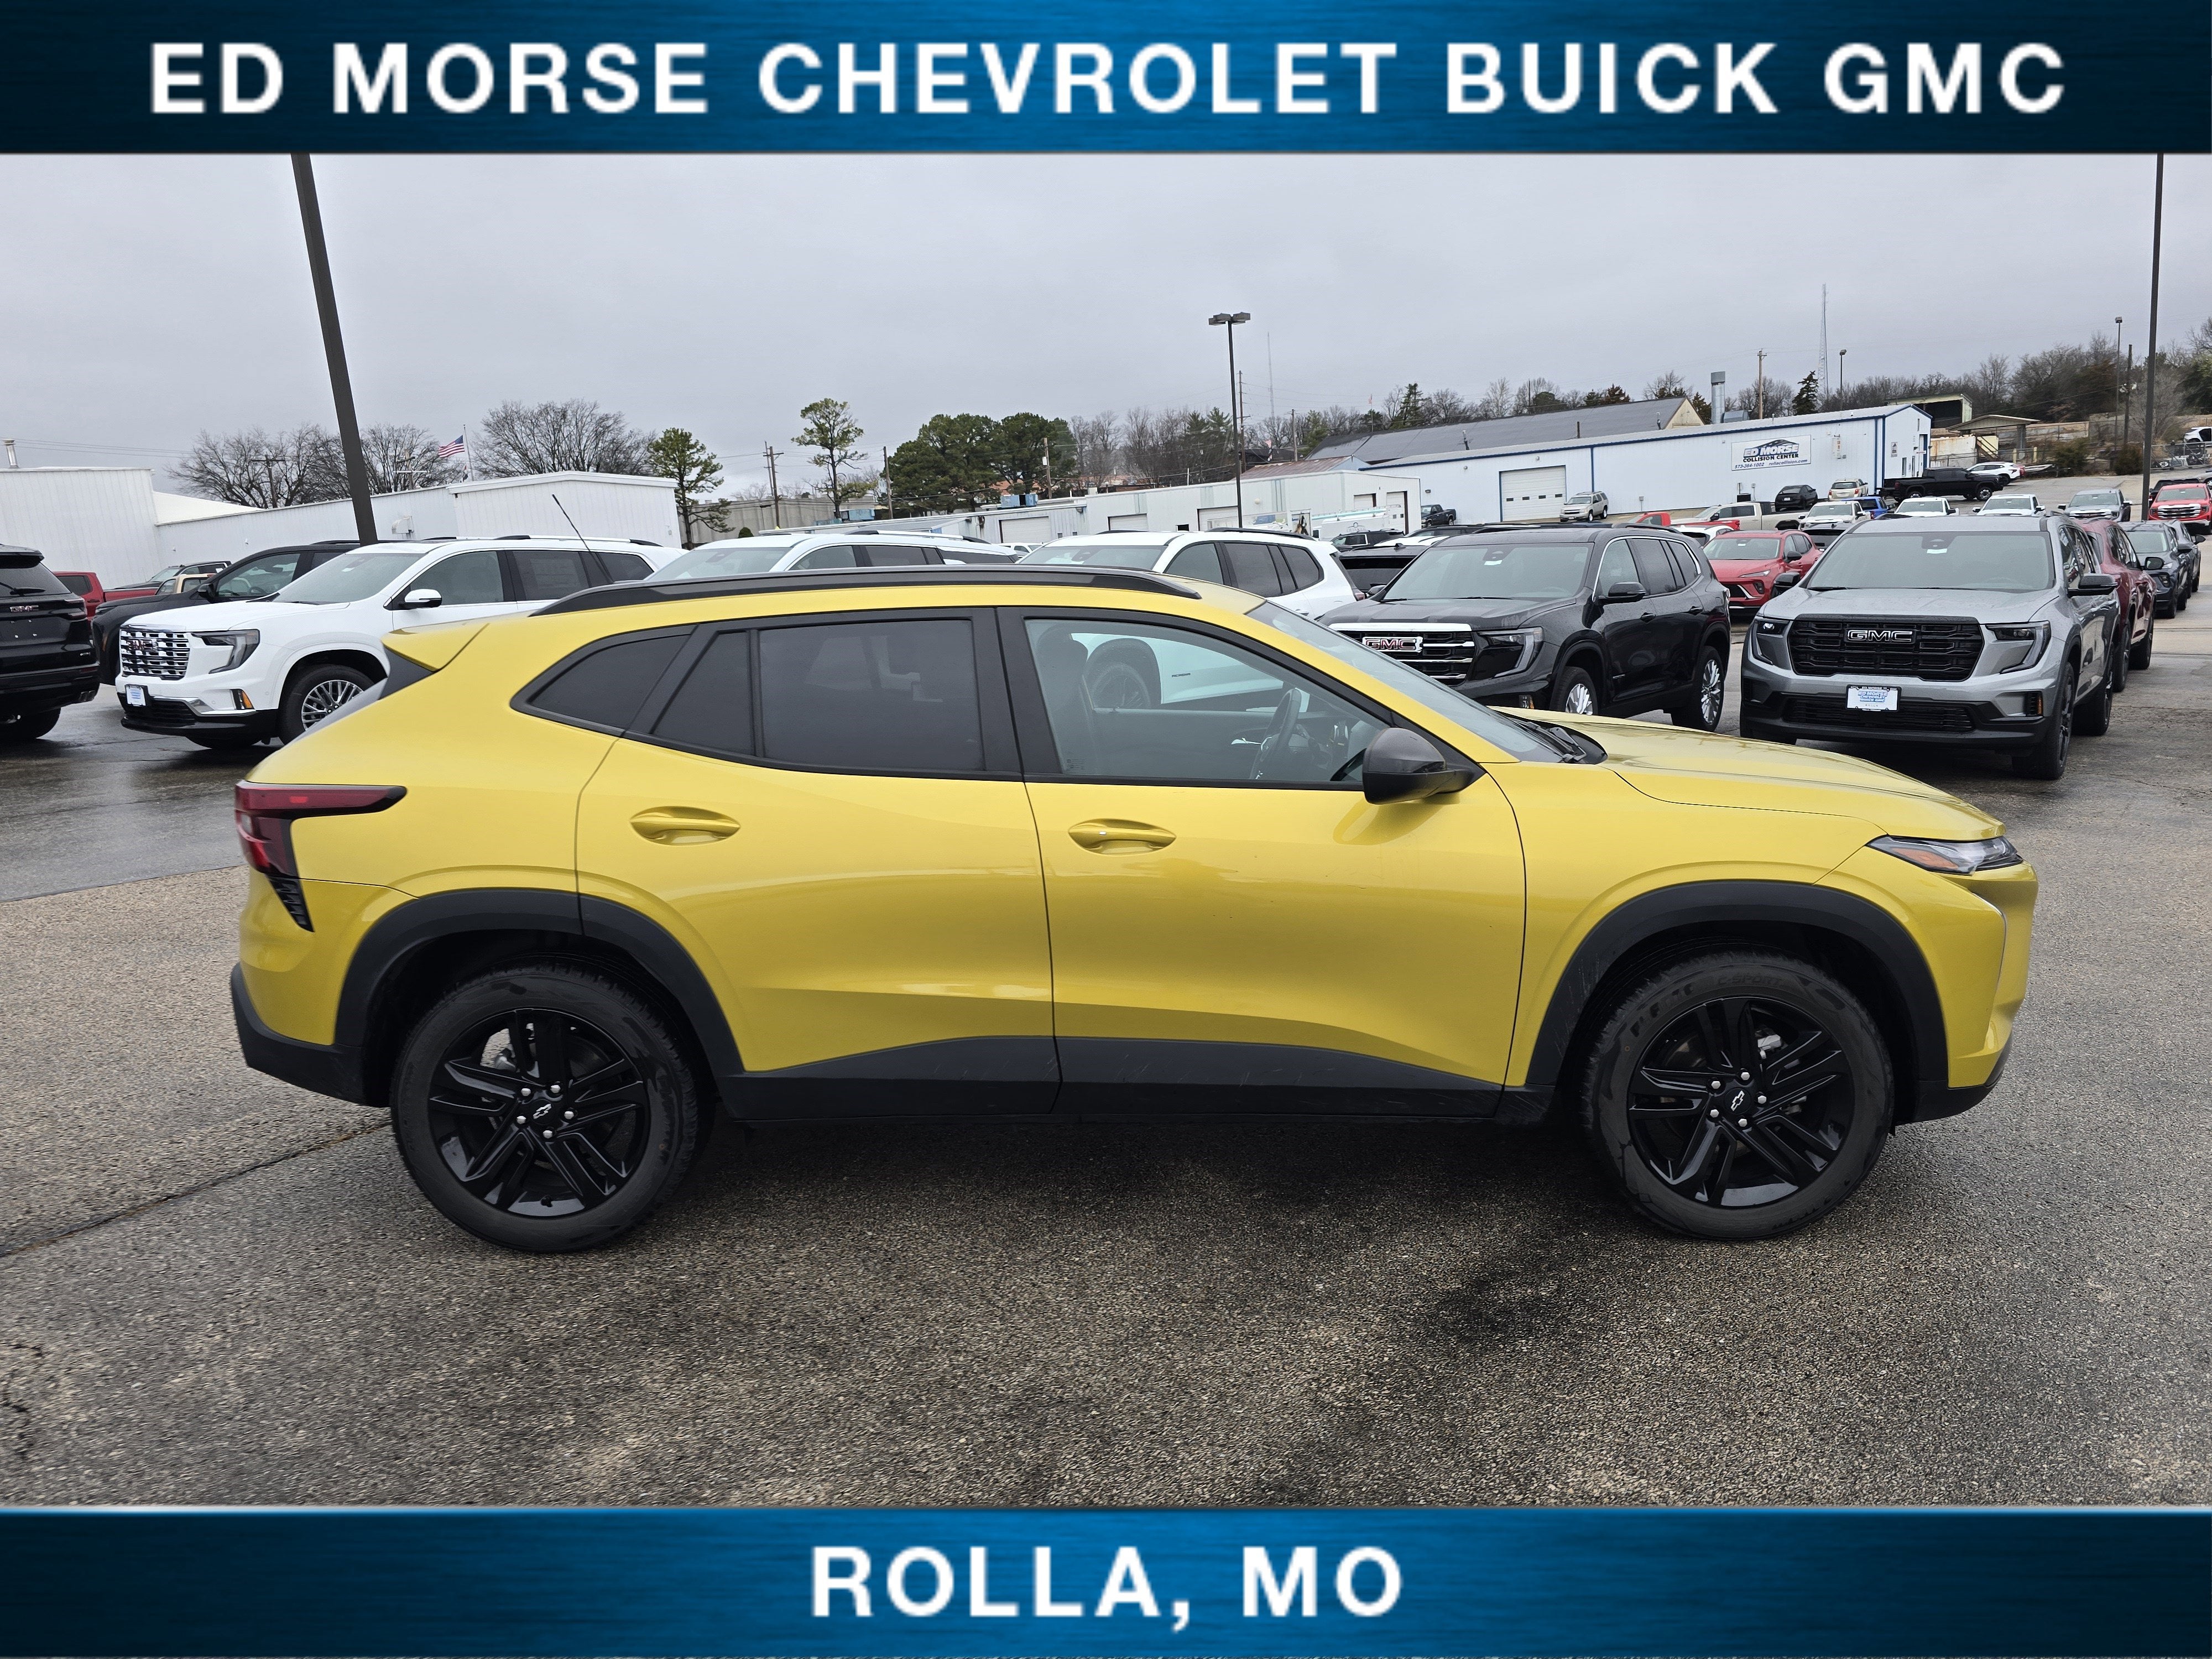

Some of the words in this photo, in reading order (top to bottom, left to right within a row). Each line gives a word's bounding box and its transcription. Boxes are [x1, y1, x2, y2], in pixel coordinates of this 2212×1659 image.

[1744, 448, 1759, 457] ED
[1759, 444, 1799, 456] MORSE
[1848, 630, 1913, 642] GMC
[1366, 639, 1416, 650] GMC
